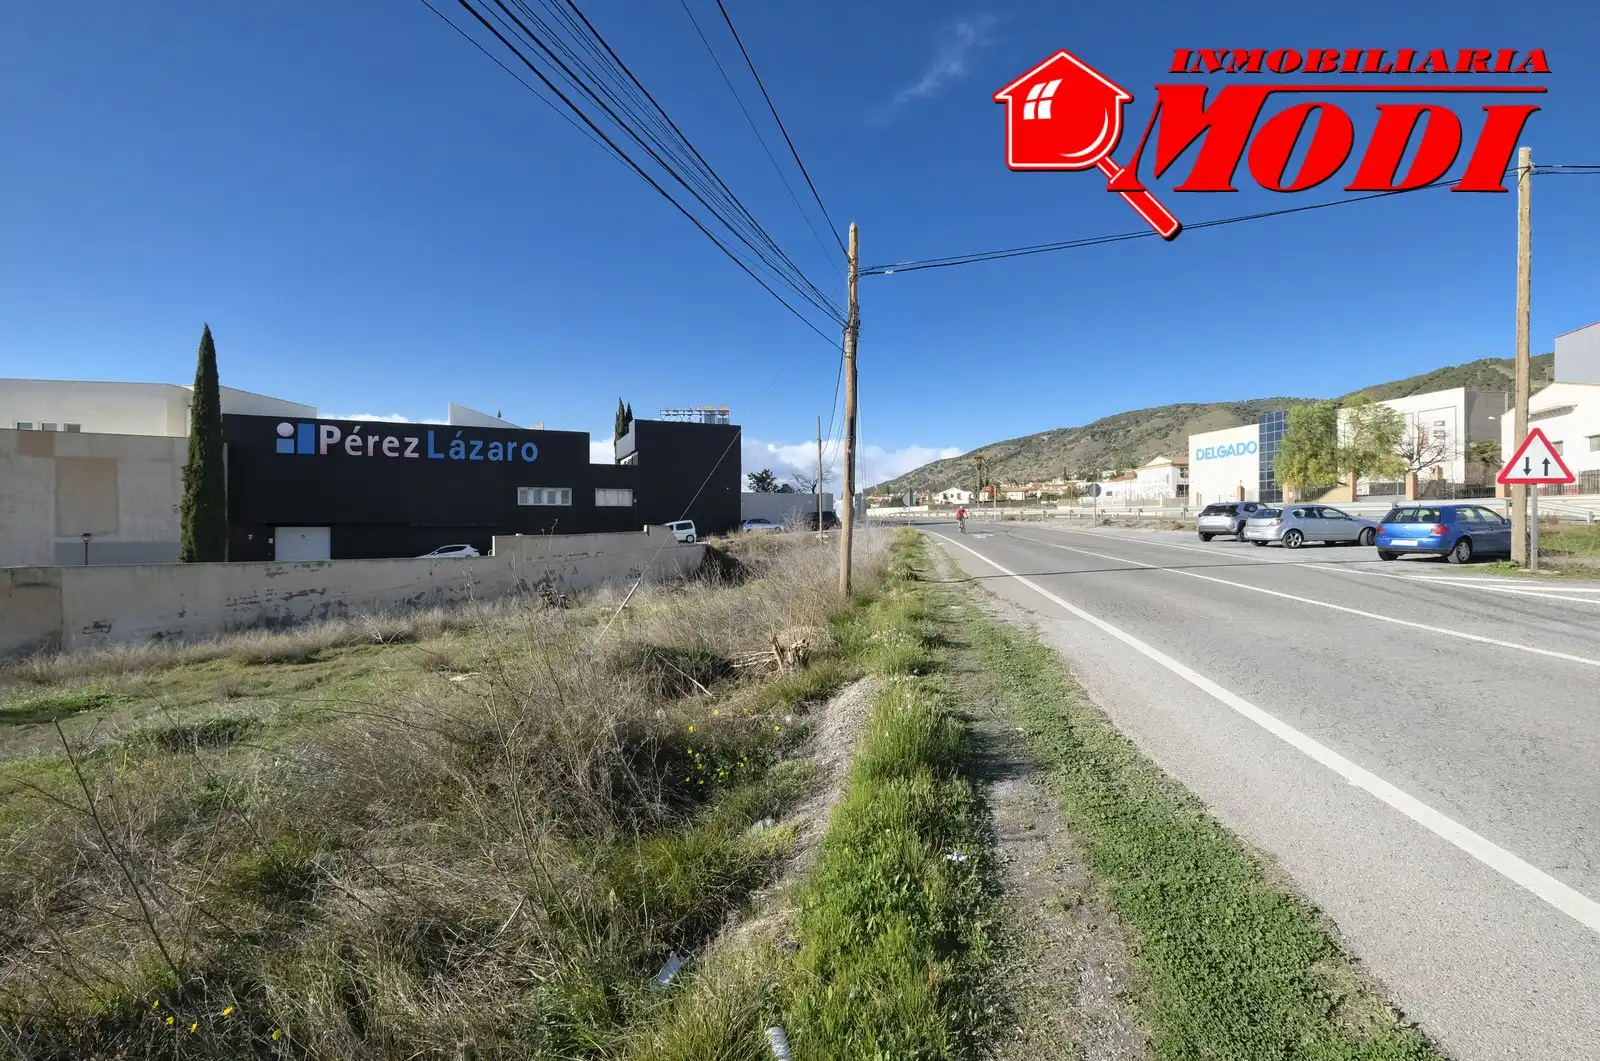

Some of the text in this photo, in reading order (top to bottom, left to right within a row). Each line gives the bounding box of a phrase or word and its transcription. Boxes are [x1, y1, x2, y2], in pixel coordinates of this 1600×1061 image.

[319, 424, 538, 462] Pérez Lázaro
[1196, 440, 1257, 461] DELGADO
